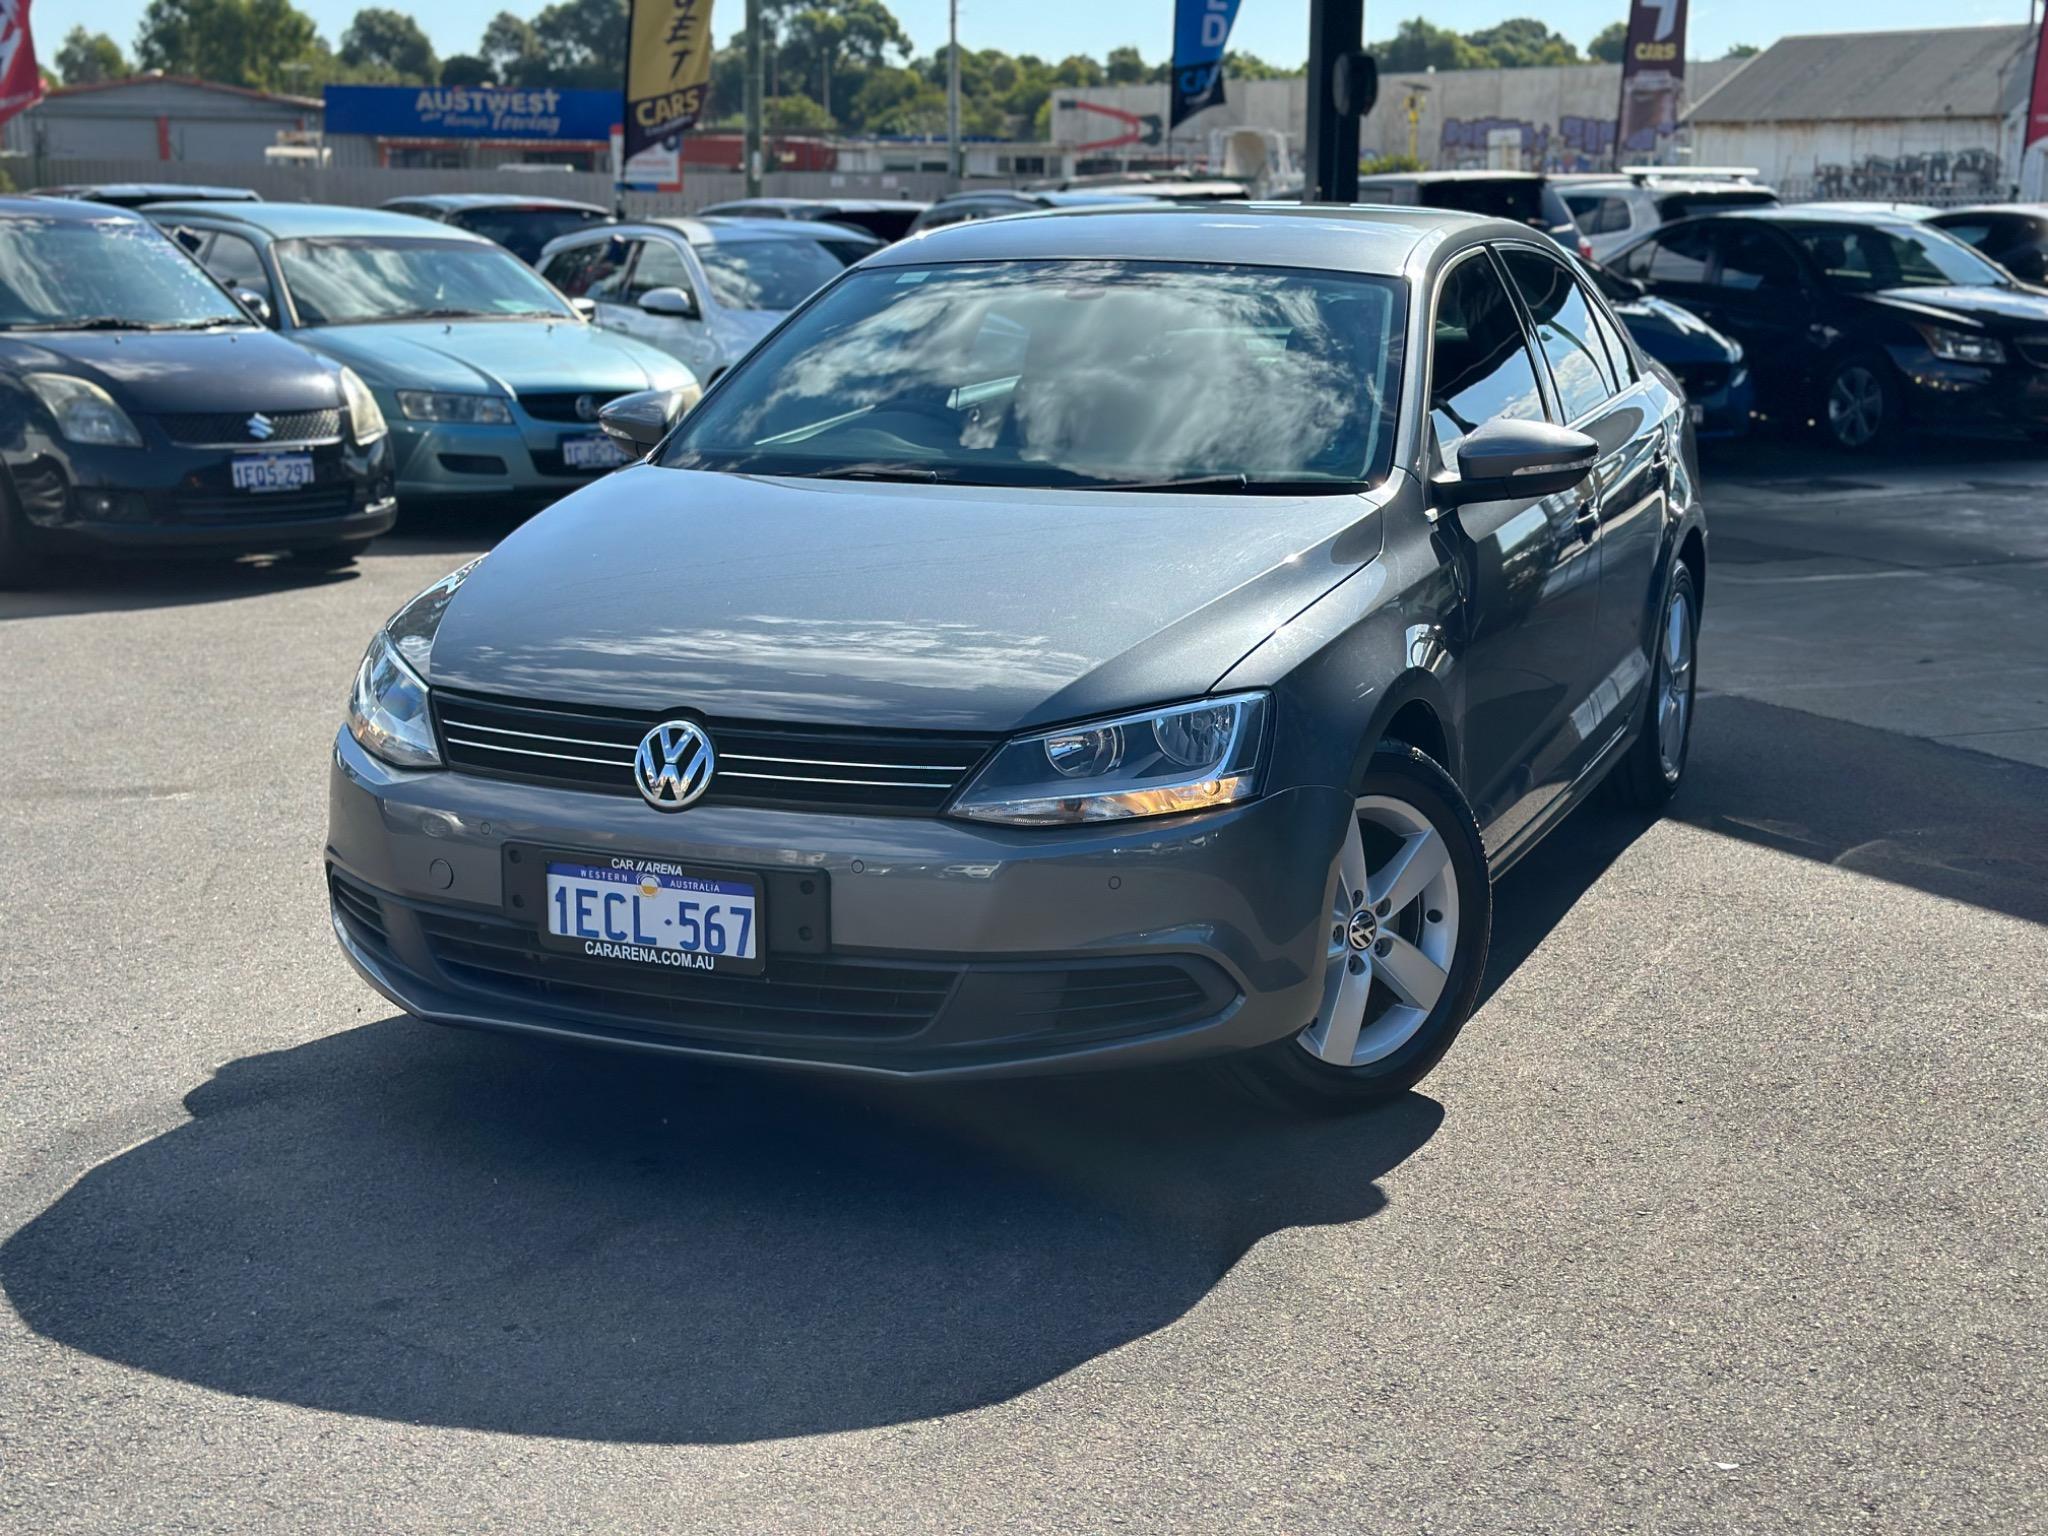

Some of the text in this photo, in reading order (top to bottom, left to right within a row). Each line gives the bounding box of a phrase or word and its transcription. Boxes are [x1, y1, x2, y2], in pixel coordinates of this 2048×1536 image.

[415, 88, 560, 113] AUSTWEST
[636, 89, 700, 127] CARS
[611, 858, 634, 872] CAR
[646, 861, 683, 877] ARENA
[580, 869, 721, 893] WESTERN AUSTRALIA
[584, 940, 715, 970] CARARENA.COM.AU
